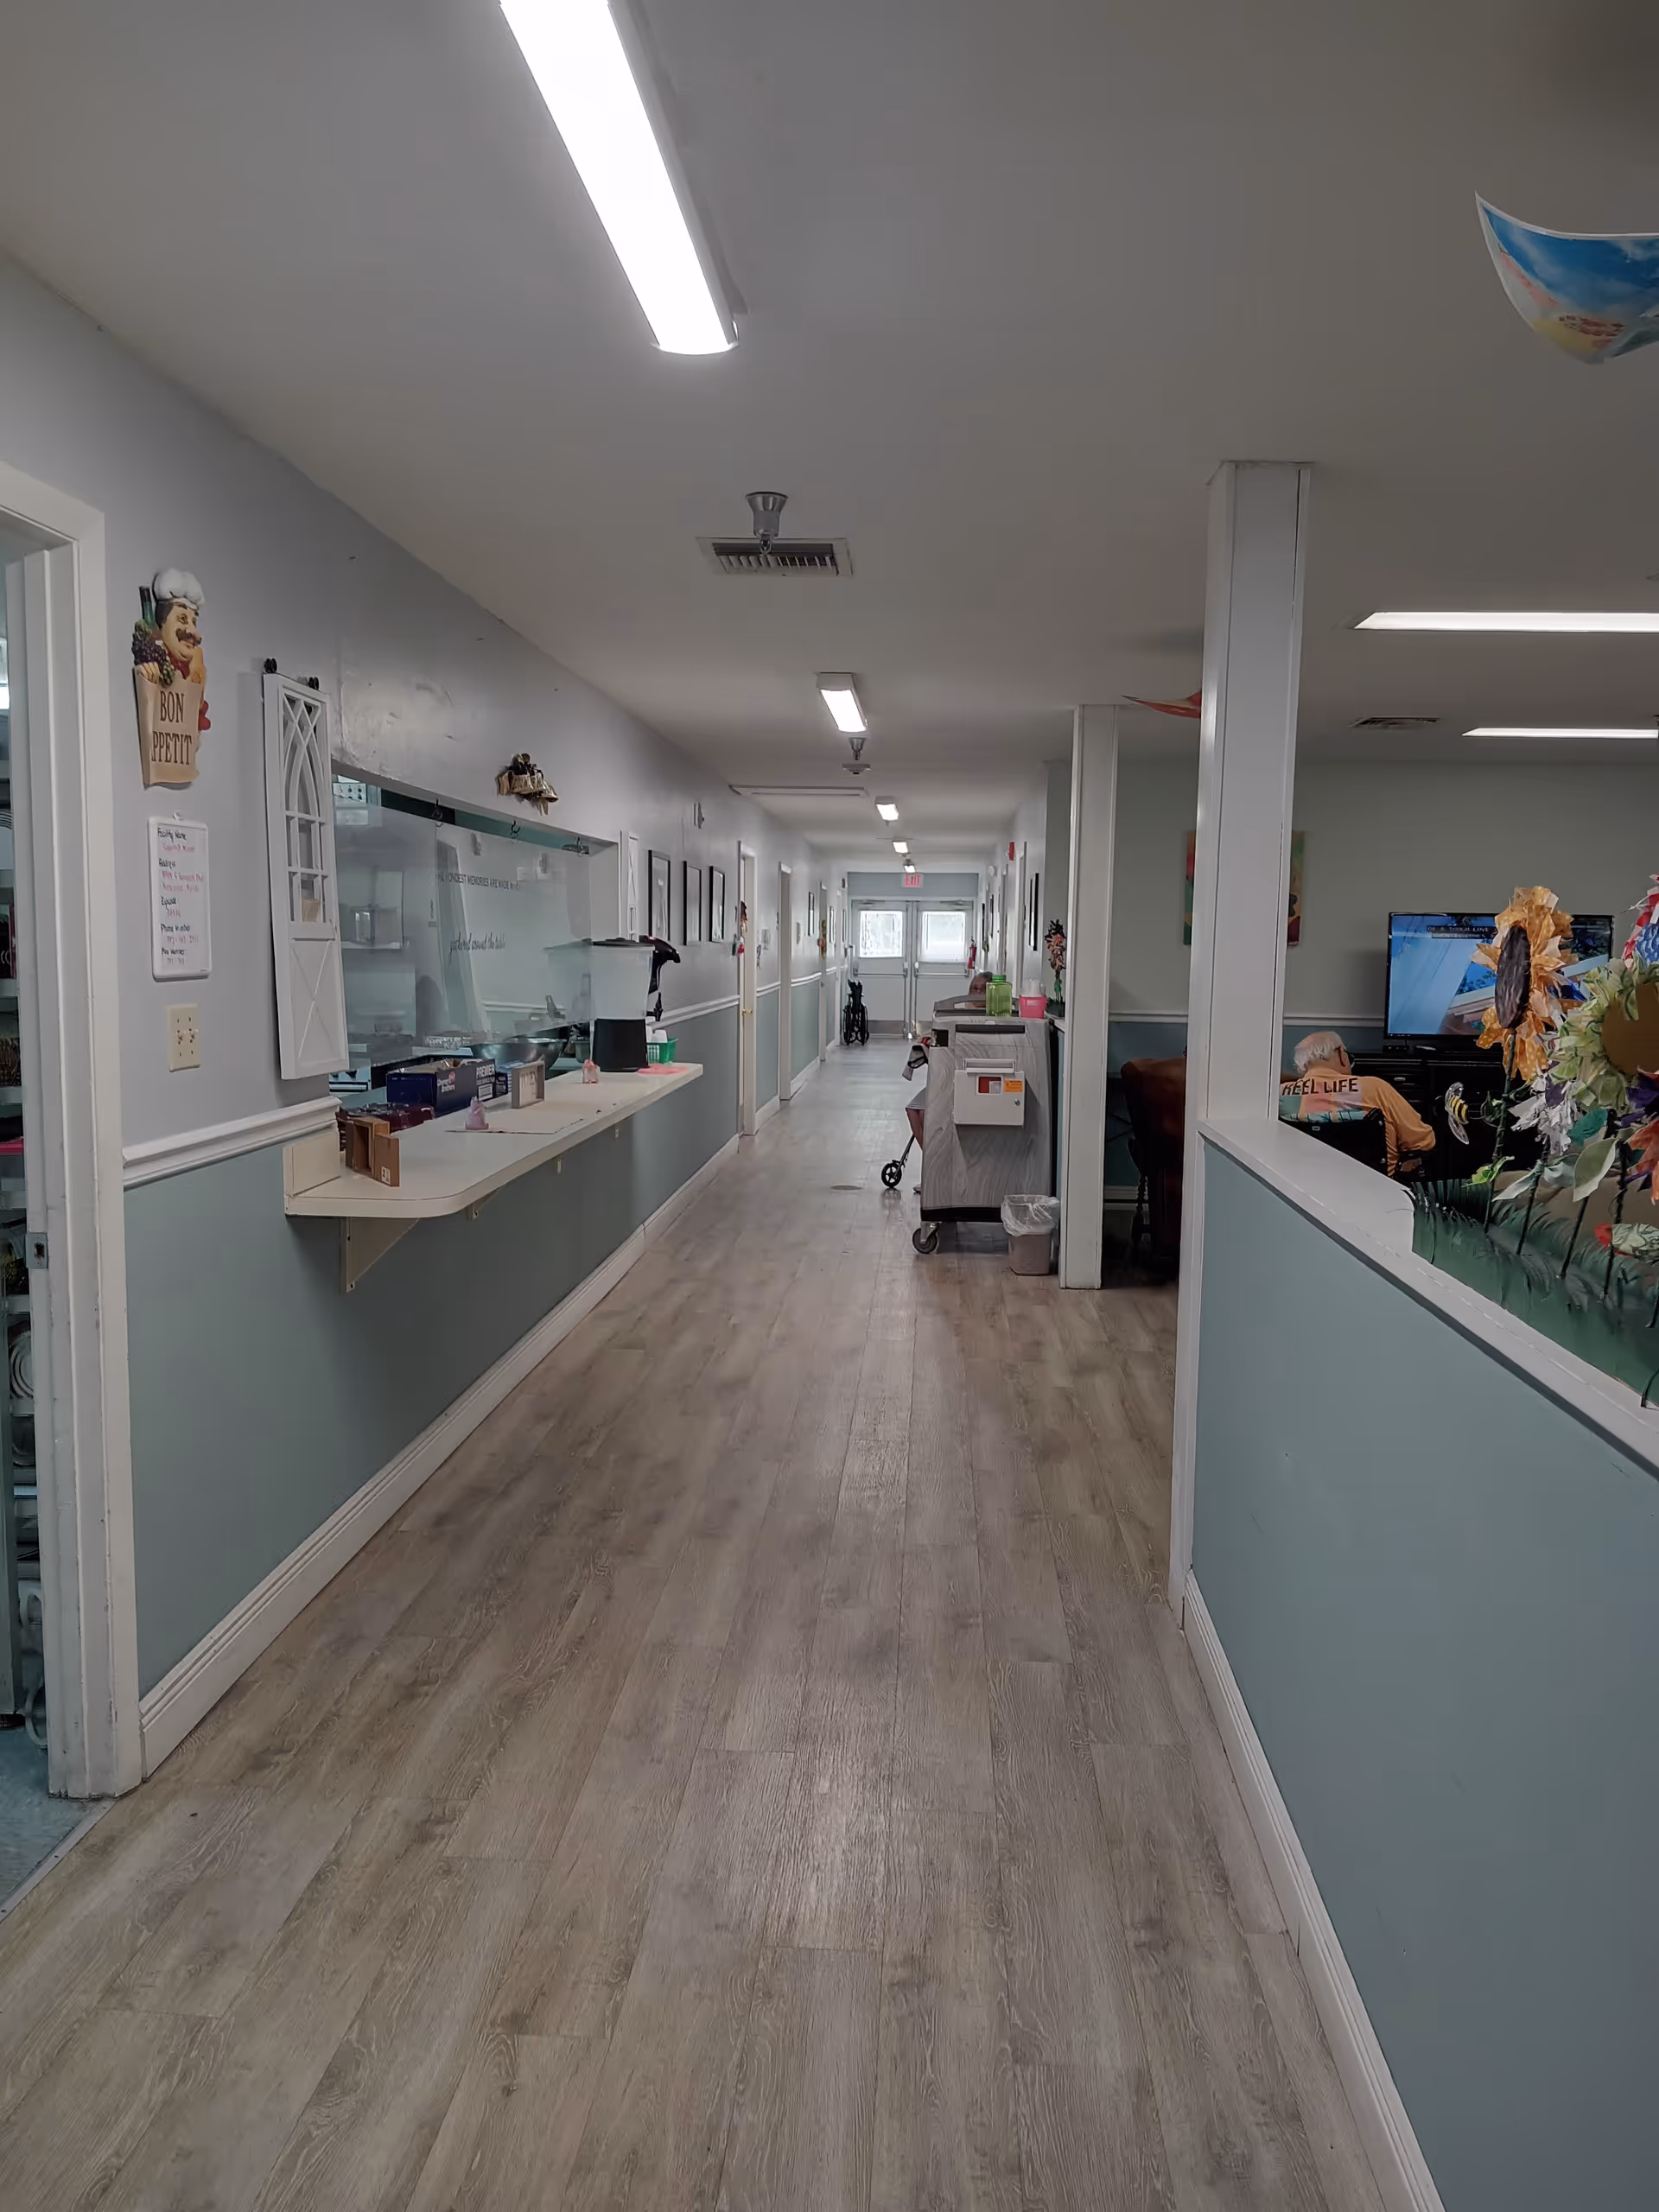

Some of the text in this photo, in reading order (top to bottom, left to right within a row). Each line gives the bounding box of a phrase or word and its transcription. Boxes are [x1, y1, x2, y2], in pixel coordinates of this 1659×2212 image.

[160, 690, 185, 723] BON
[151, 730, 193, 766] PPETIT
[905, 874, 921, 887] EXIT
[476, 1064, 495, 1079] PREMIER
[1324, 1077, 1358, 1094] LIFE
